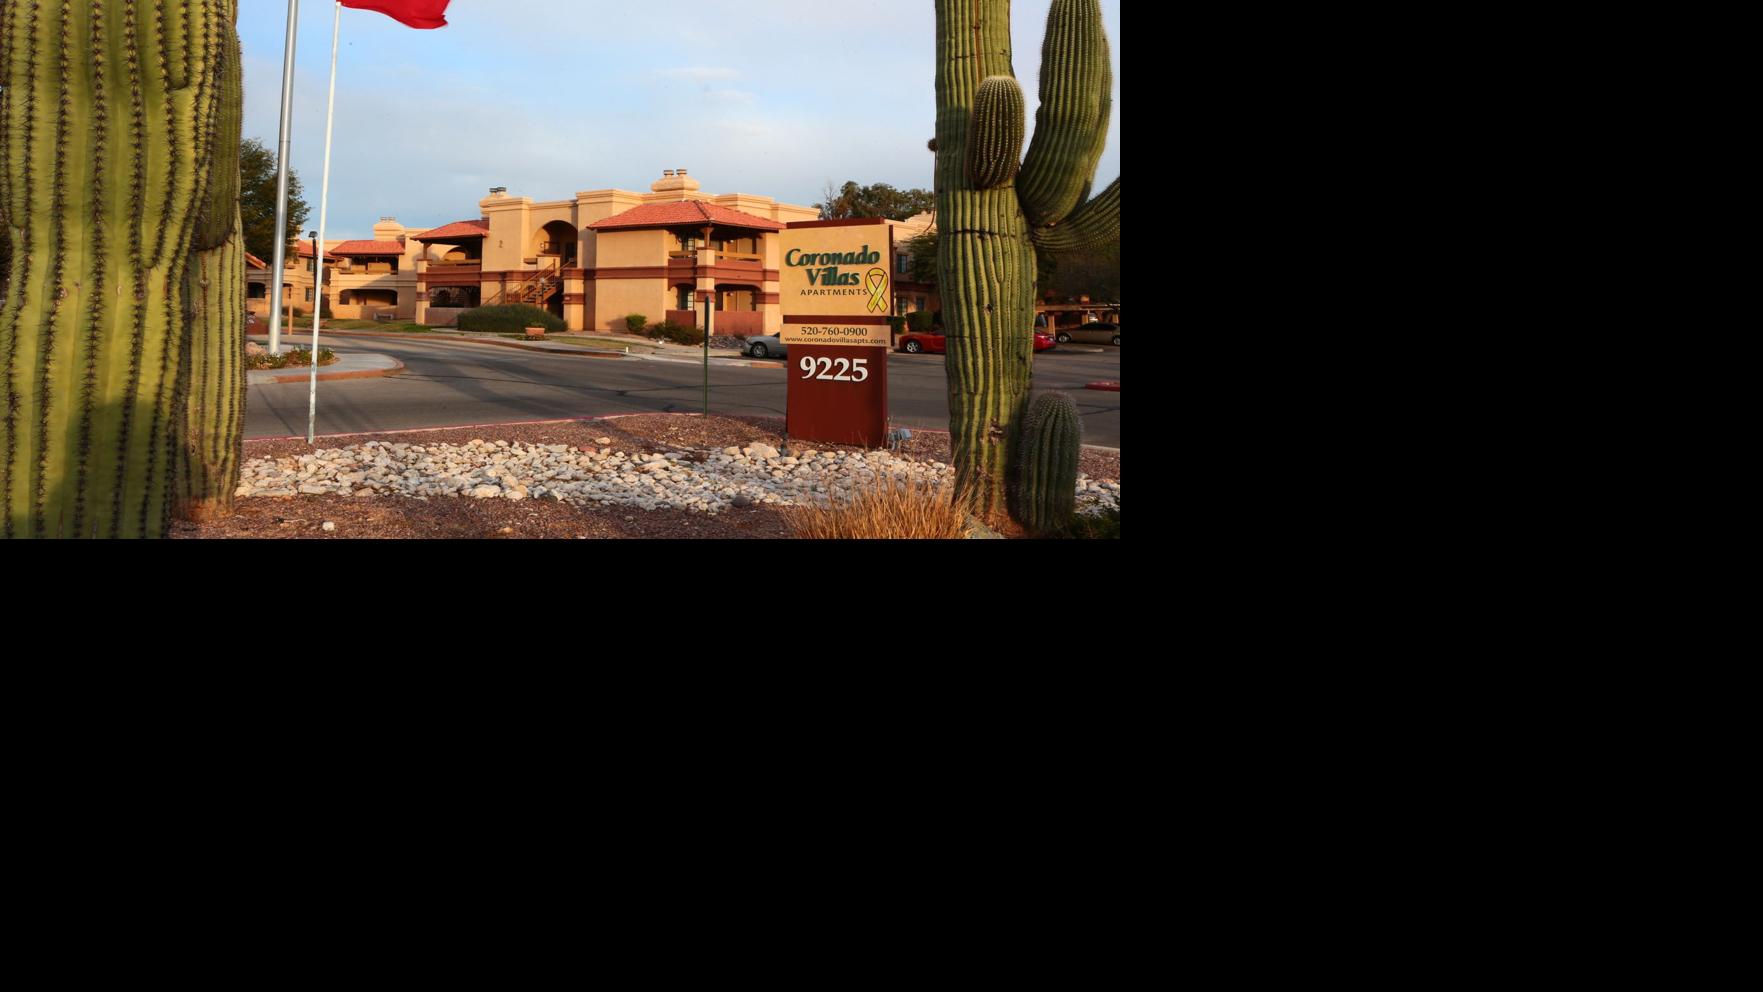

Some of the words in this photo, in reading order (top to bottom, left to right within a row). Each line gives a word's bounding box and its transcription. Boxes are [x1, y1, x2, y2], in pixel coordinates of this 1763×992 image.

[785, 245, 880, 267] Coronado
[805, 266, 860, 286] Villas
[800, 288, 867, 296] APARTMENTS
[801, 327, 868, 336] 520-760-0900
[784, 336, 886, 344] www.coronadovillasapts.com
[800, 356, 868, 382] 9225
